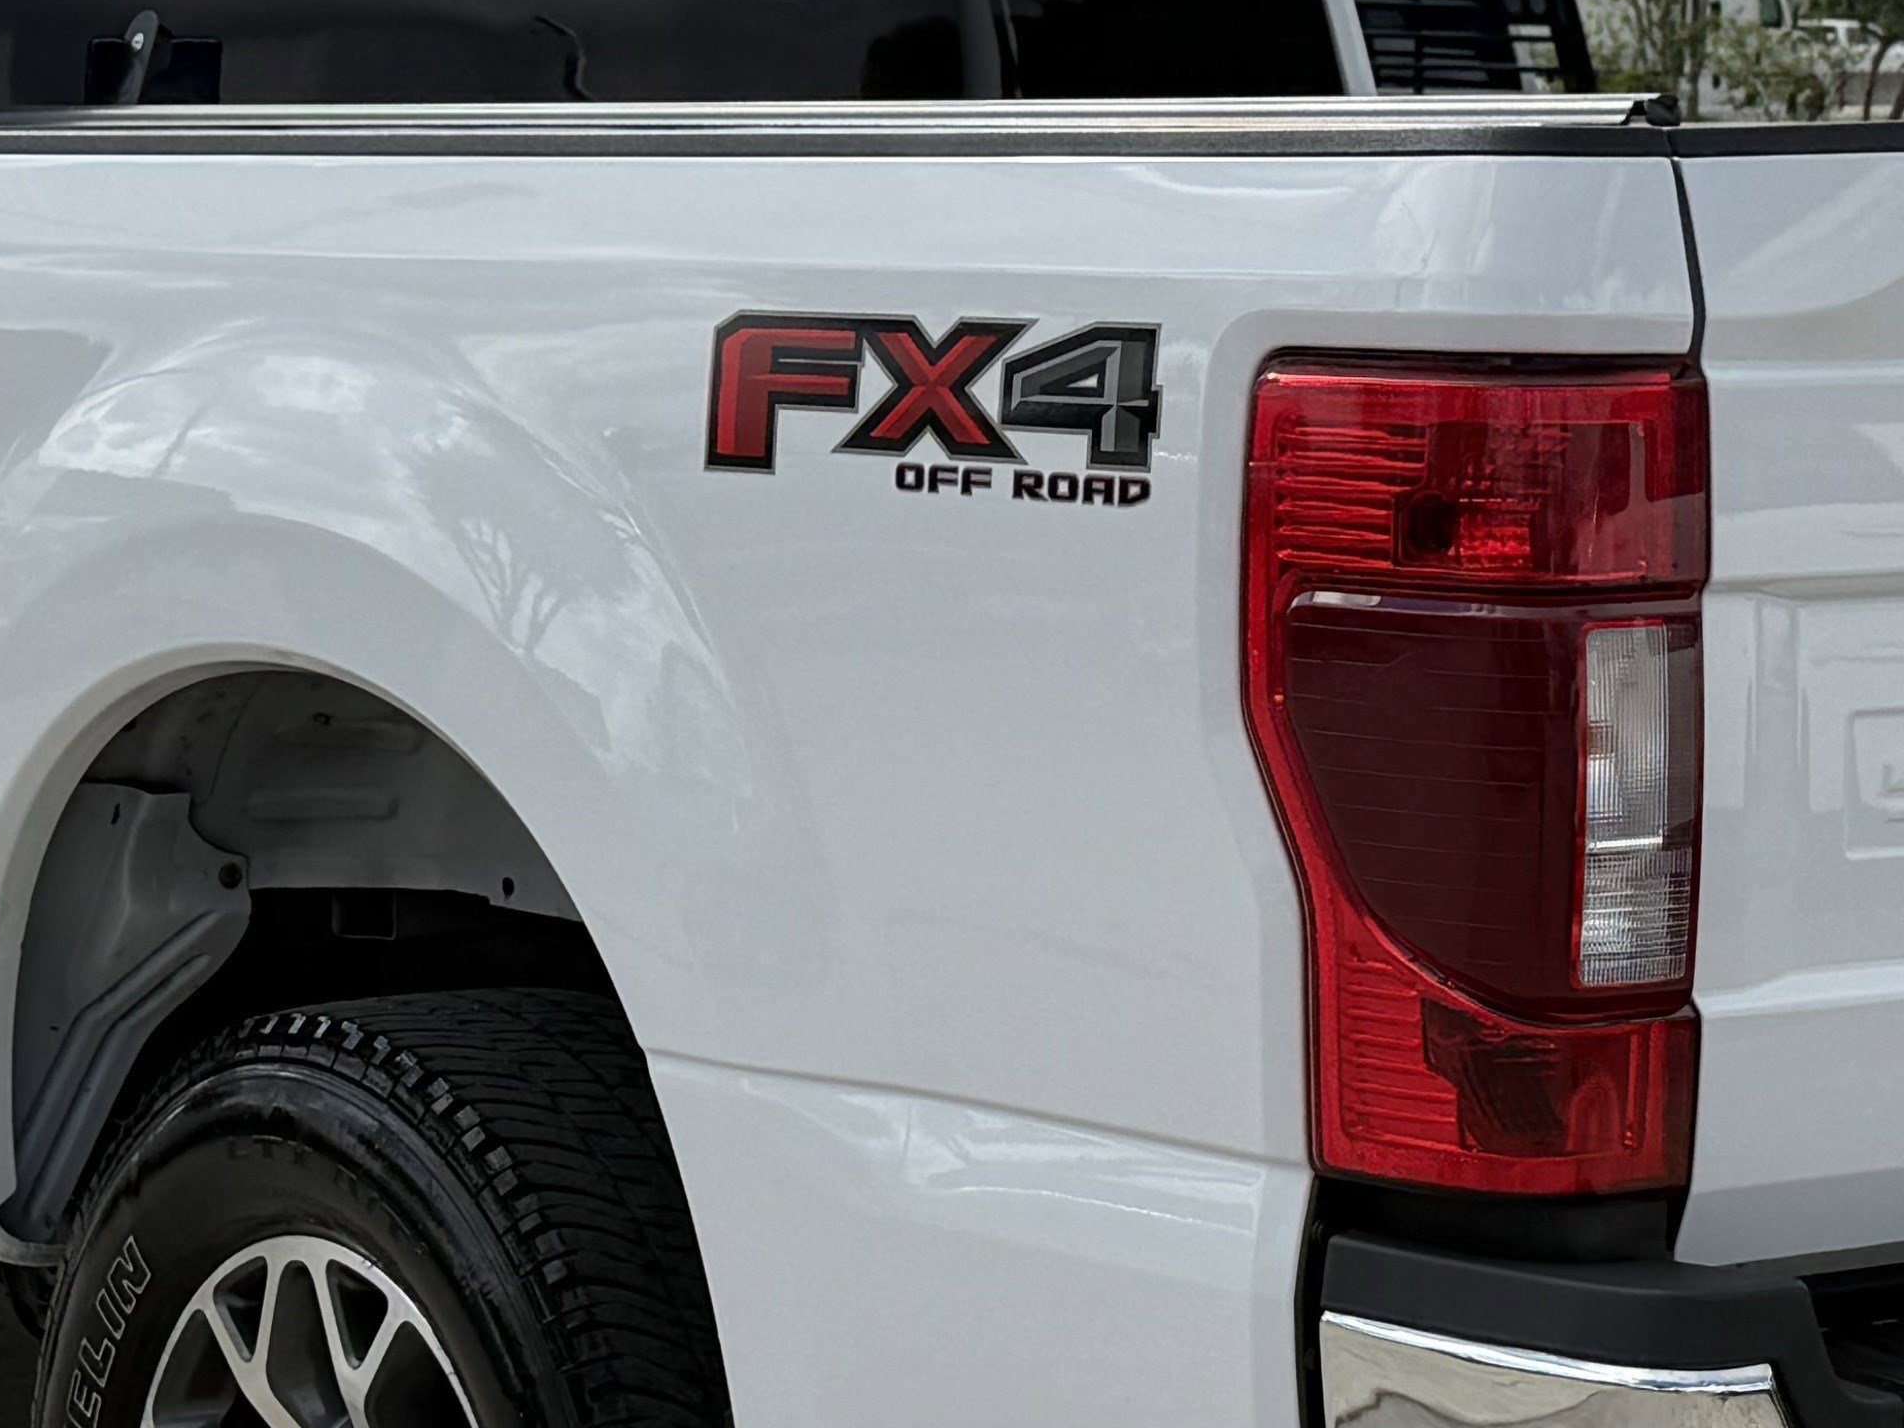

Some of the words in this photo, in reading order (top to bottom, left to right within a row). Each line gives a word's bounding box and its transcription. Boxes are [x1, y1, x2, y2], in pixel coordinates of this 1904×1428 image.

[704, 309, 1164, 474] FX4
[895, 461, 993, 495] OFF
[1011, 469, 1152, 508] ROAD
